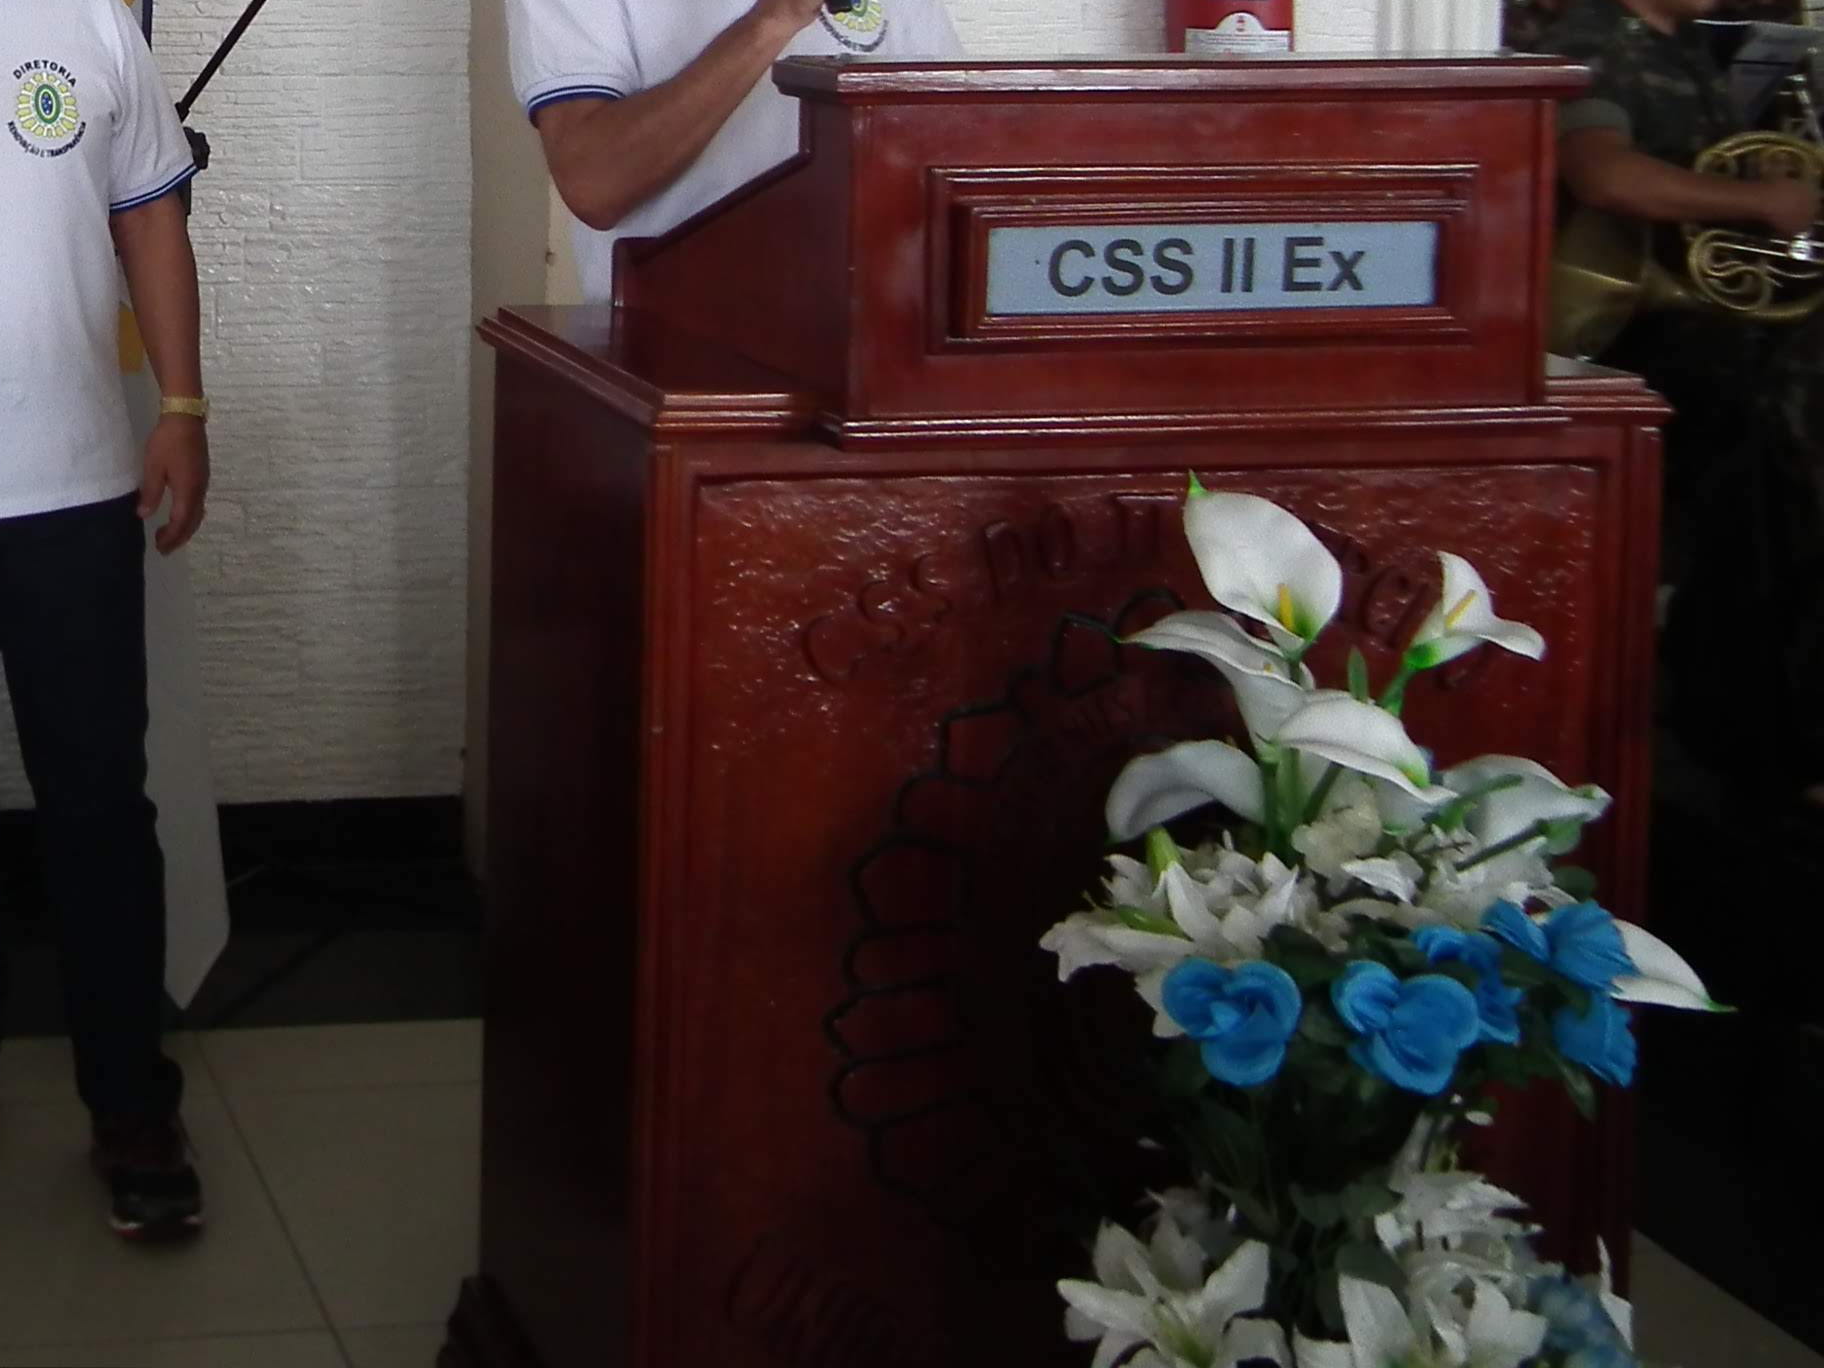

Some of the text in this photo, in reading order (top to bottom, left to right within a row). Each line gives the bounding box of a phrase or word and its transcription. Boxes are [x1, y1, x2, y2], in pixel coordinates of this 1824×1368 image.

[13, 60, 77, 87] DIRETORIA
[1049, 236, 1365, 297] CSS II Ex
